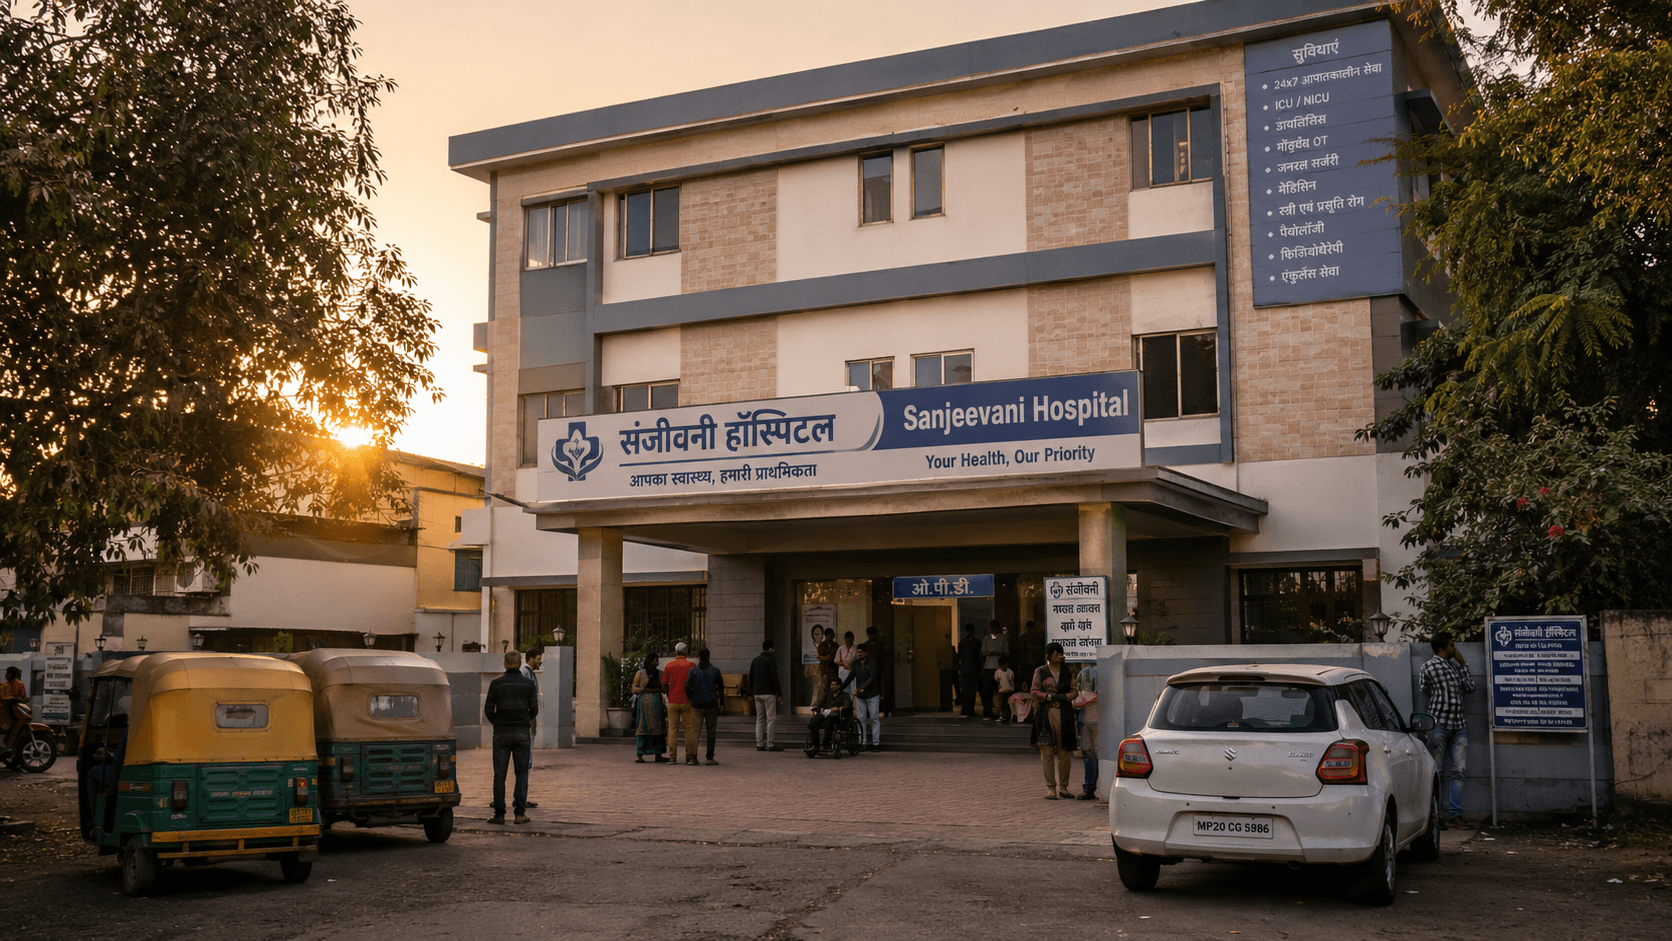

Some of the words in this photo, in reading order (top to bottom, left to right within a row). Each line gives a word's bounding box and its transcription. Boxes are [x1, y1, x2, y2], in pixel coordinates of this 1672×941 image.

[1274, 77, 1299, 90] 24x7
[1302, 66, 1361, 86] आपातकालीन
[1363, 61, 1383, 75] सेवा
[1275, 98, 1293, 111] ICU
[1296, 96, 1301, 108] /
[1303, 92, 1330, 106] NICU
[1313, 135, 1328, 147] OT
[1277, 160, 1308, 174] जनरल
[1298, 200, 1314, 214] एवं
[1347, 194, 1365, 208] रोग
[1319, 264, 1340, 278] सेवा
[903, 396, 1025, 435] Sanjeevani
[1033, 389, 1129, 426] Hospital
[619, 413, 718, 455] संजीवनी
[724, 408, 836, 452] हॉस्पिटल
[925, 454, 957, 470] Your
[961, 450, 1010, 467] Health,
[1014, 447, 1040, 464] Our
[1044, 444, 1096, 464] Priority
[630, 473, 668, 487] आपका
[671, 470, 715, 486] स्वास्थ्य,
[719, 463, 752, 484] हमारी
[755, 461, 817, 481] प्राथमिकता
[911, 577, 974, 596] ओ.पी.डी.
[1197, 821, 1226, 832] MP20
[1228, 822, 1242, 832] CG
[1244, 823, 1270, 834] 5986
